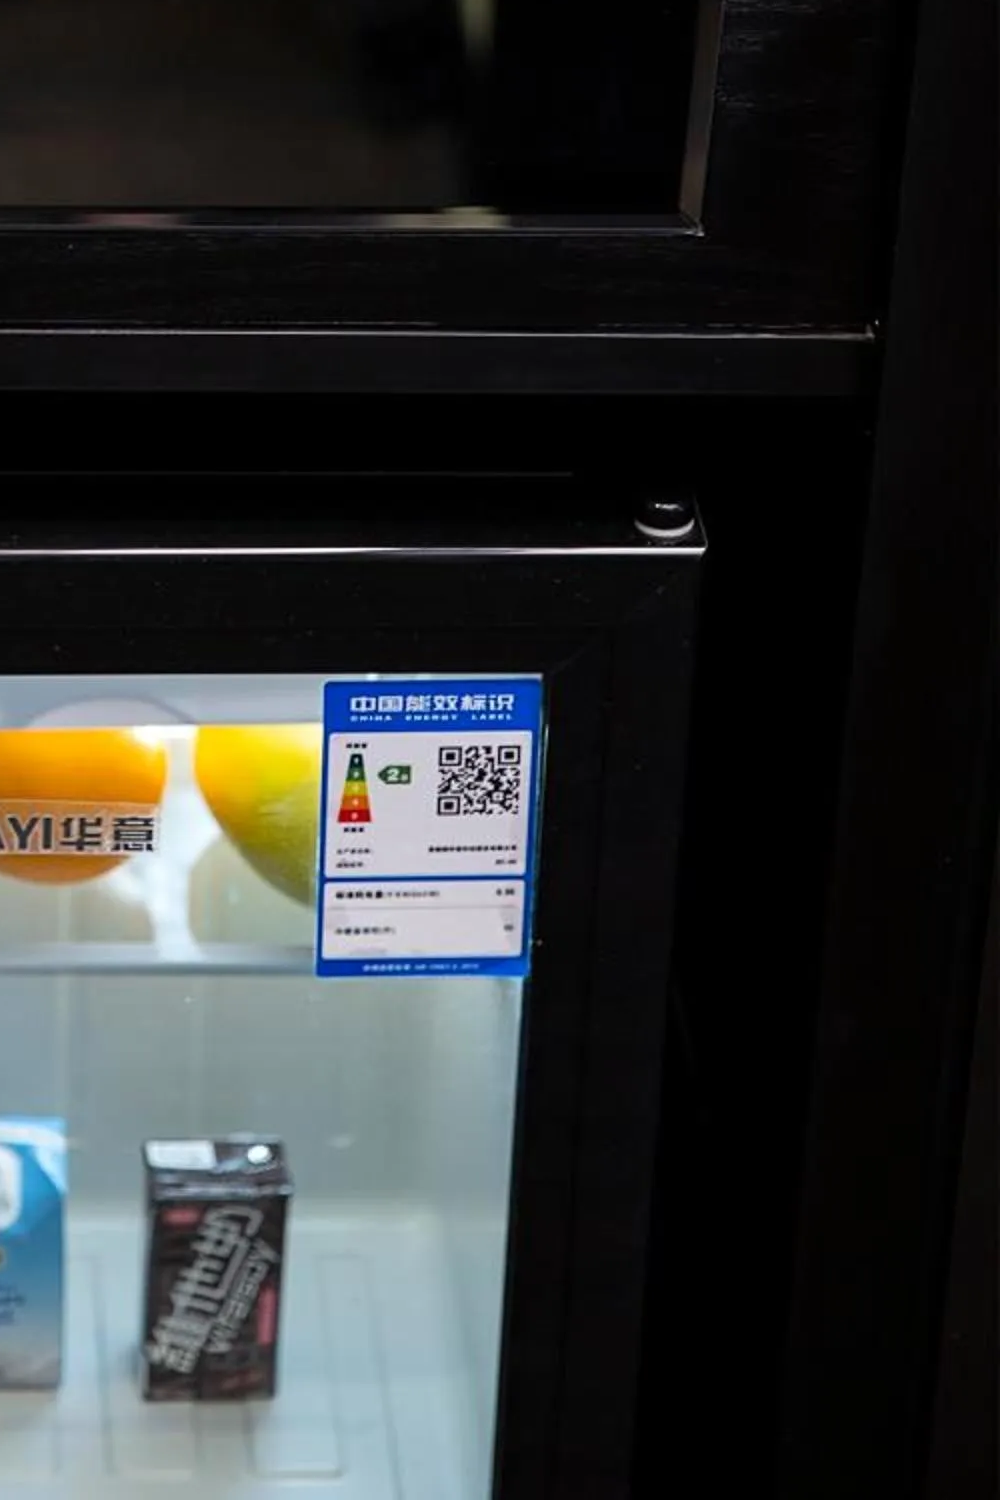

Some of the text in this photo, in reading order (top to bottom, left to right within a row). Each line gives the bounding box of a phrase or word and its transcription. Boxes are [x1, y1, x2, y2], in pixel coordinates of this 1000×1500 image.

[350, 694, 515, 713] 中国能效标识
